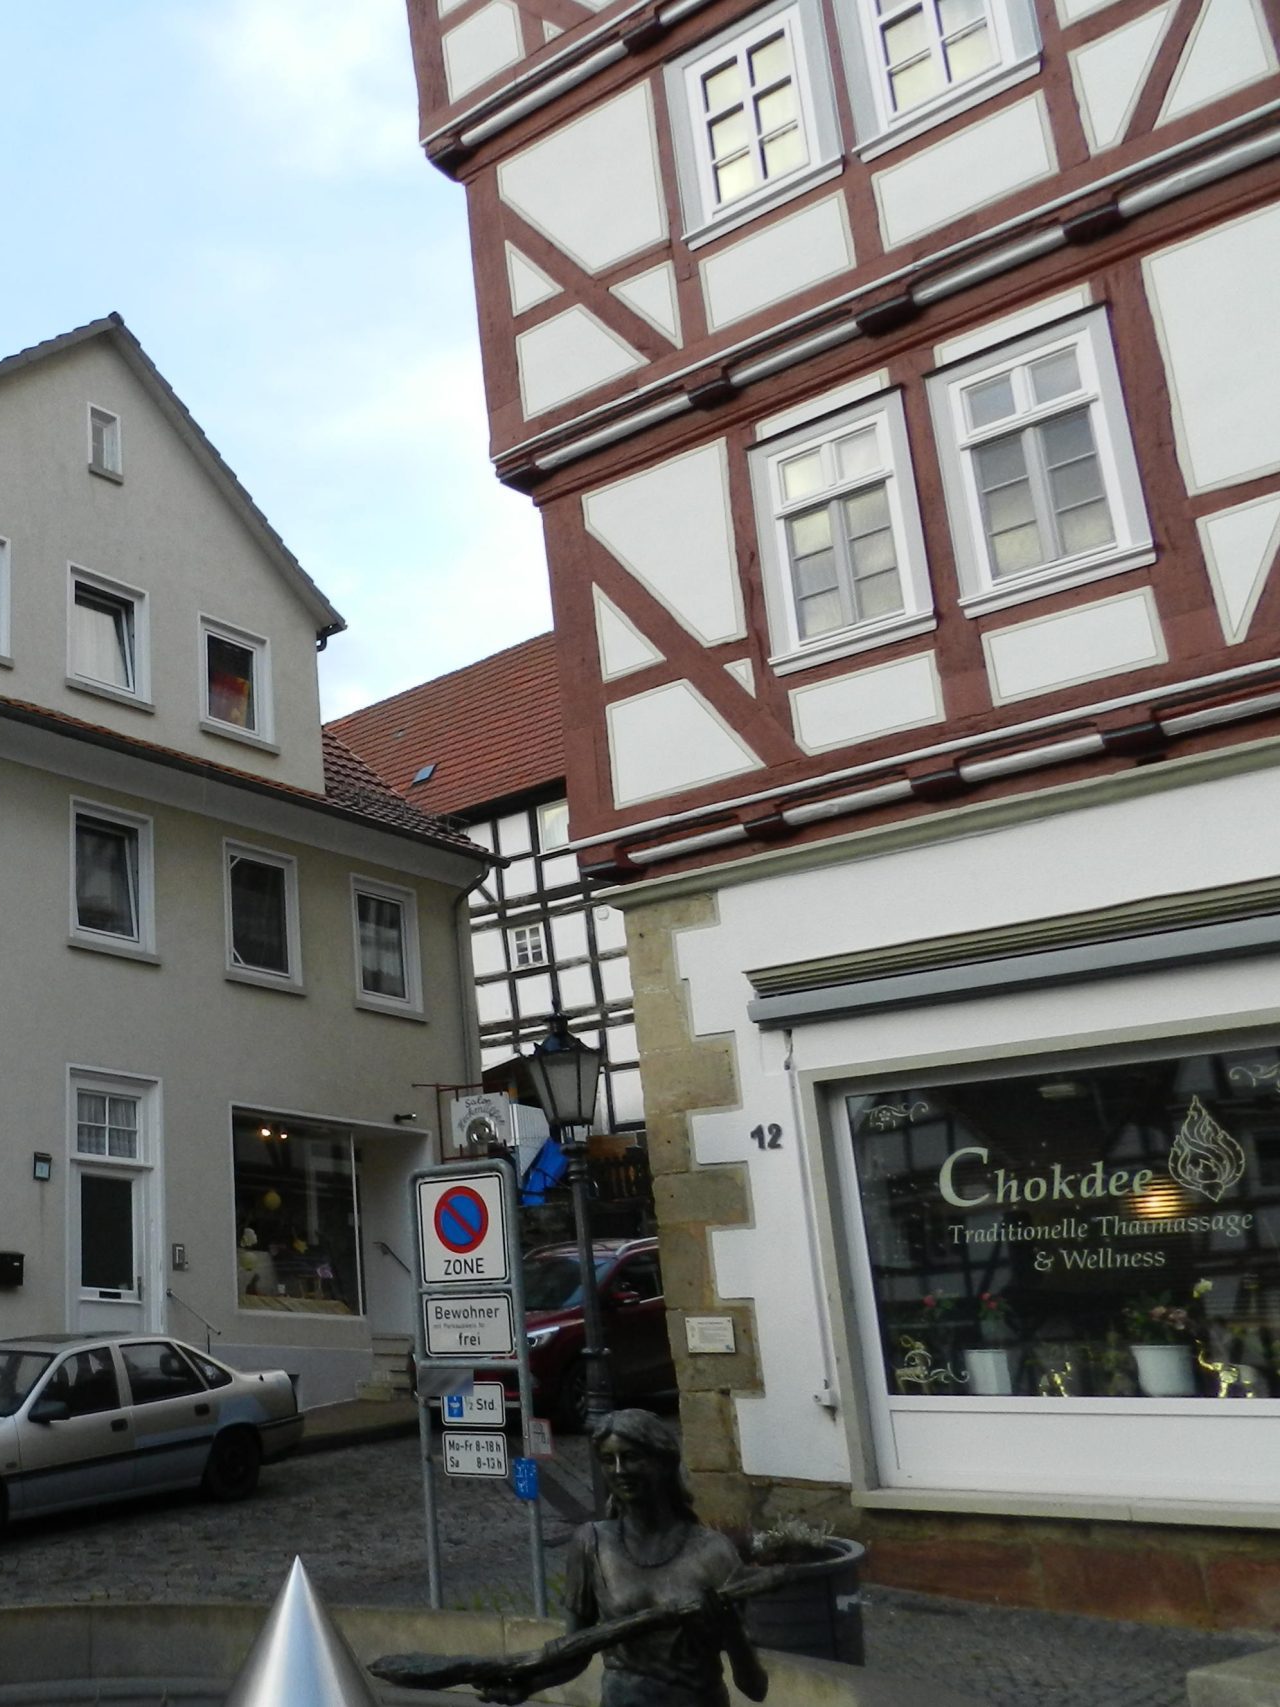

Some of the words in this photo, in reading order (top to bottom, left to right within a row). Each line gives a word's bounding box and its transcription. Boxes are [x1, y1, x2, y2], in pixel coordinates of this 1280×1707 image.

[751, 1123, 782, 1149] 12
[939, 1146, 1155, 1207] Chokdee
[948, 1218, 1089, 1245] Traditionelle
[1095, 1212, 1254, 1238] Thaimassage
[444, 1258, 485, 1275] ZONE
[1033, 1250, 1055, 1272] &
[1062, 1247, 1166, 1270] Wellness
[434, 1304, 500, 1320] Bewohner
[458, 1332, 481, 1346] frei
[448, 1440, 472, 1451] Mo-Fr
[495, 1441, 501, 1452] h
[449, 1456, 459, 1468] Sa
[497, 1458, 502, 1469] h
